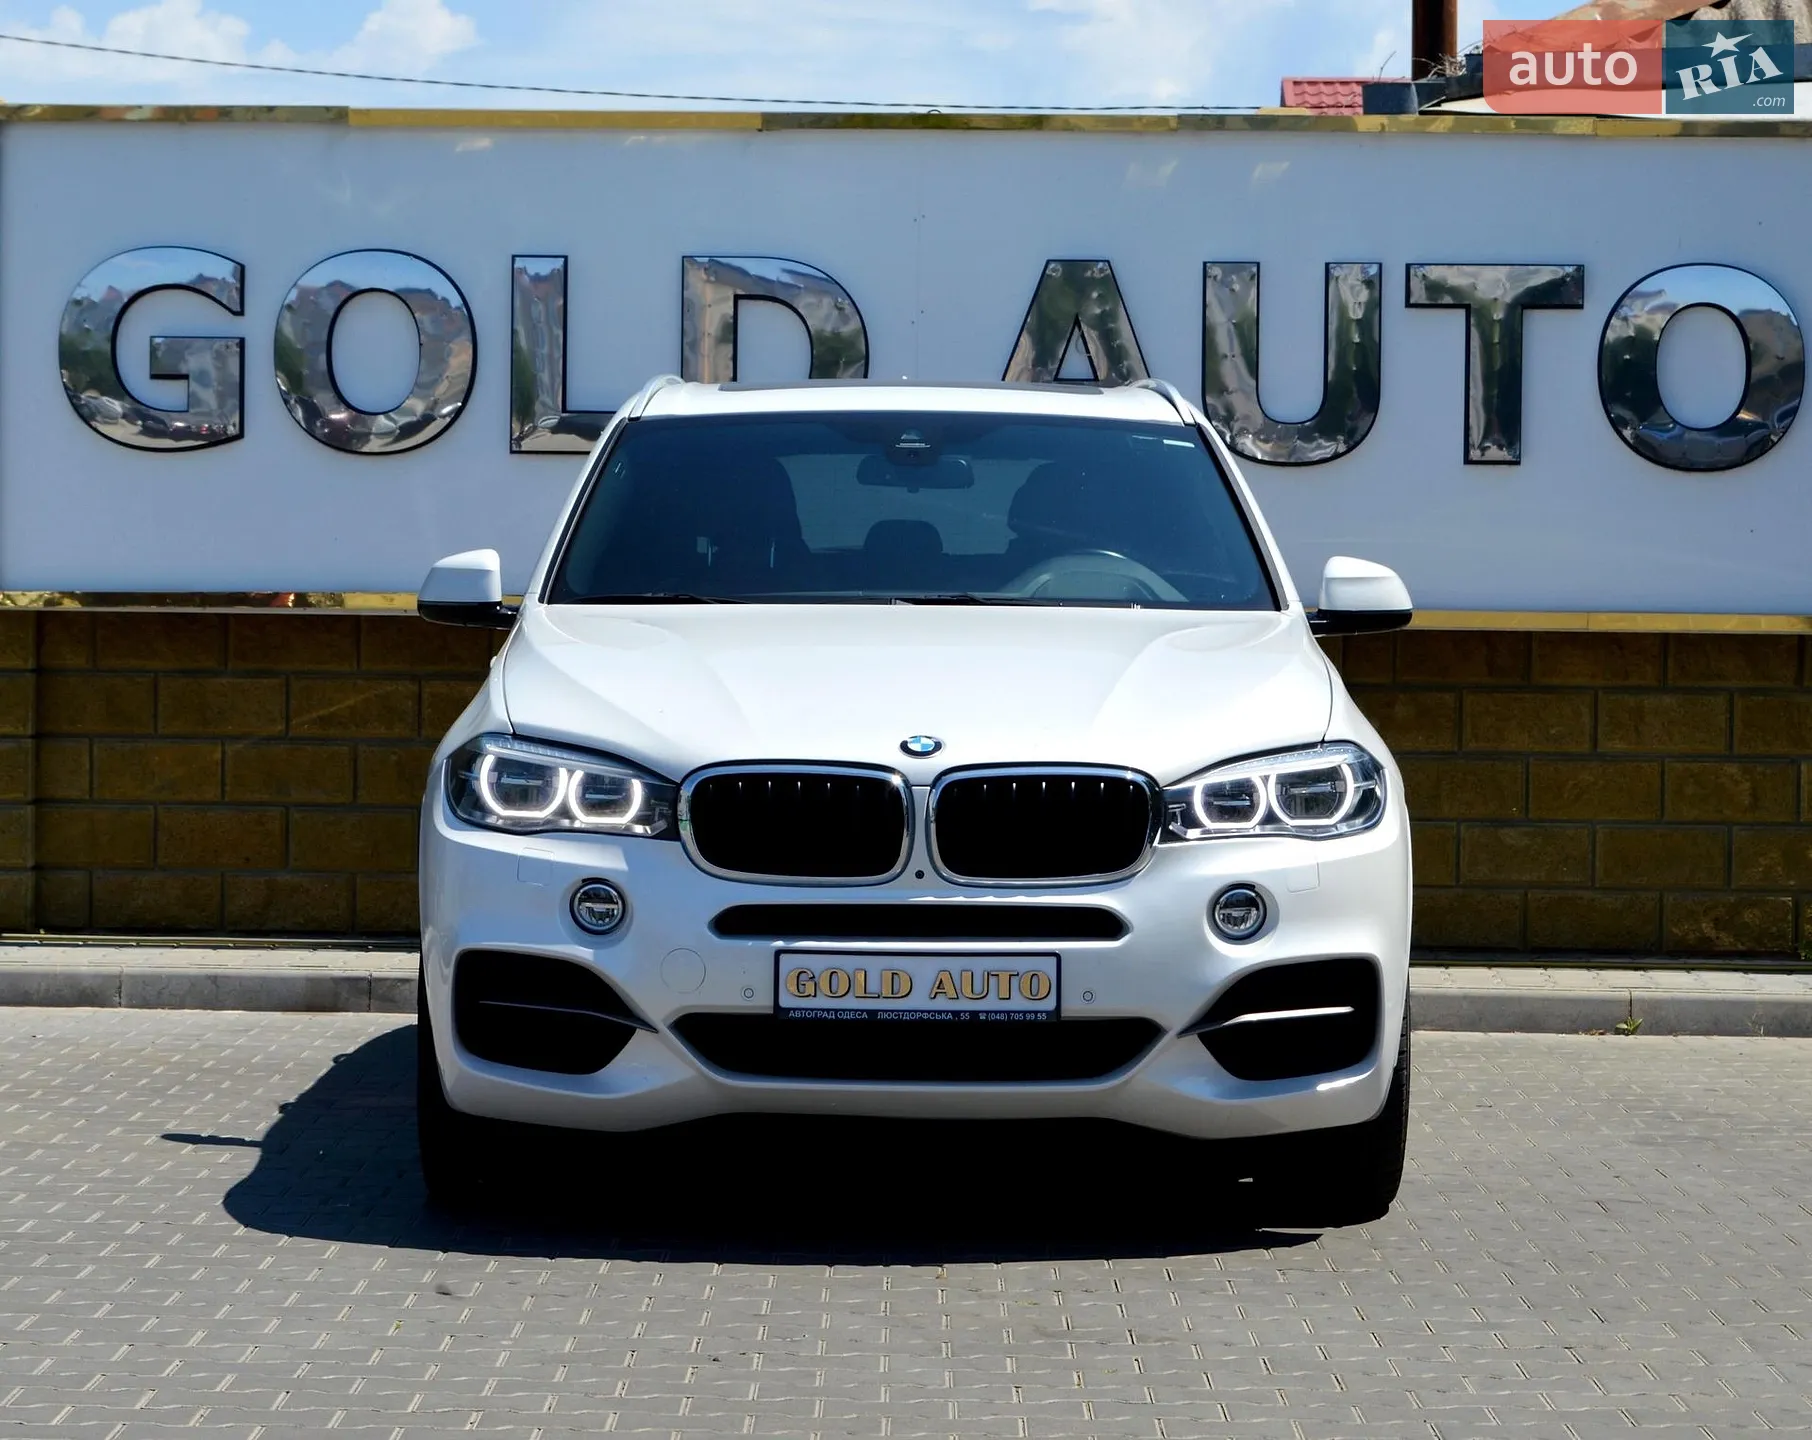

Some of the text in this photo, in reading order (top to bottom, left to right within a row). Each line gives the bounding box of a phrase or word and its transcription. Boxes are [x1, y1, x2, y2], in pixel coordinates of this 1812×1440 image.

[58, 246, 1806, 472] GOLD AUTO
[785, 967, 1052, 1001] GOLD AUTO
[788, 1010, 836, 1019] АВТОГРАД
[837, 1011, 868, 1019] ОДЕСА
[960, 1012, 970, 1020] 55
[988, 1012, 1008, 1021] (048)
[1010, 1012, 1024, 1020] 705
